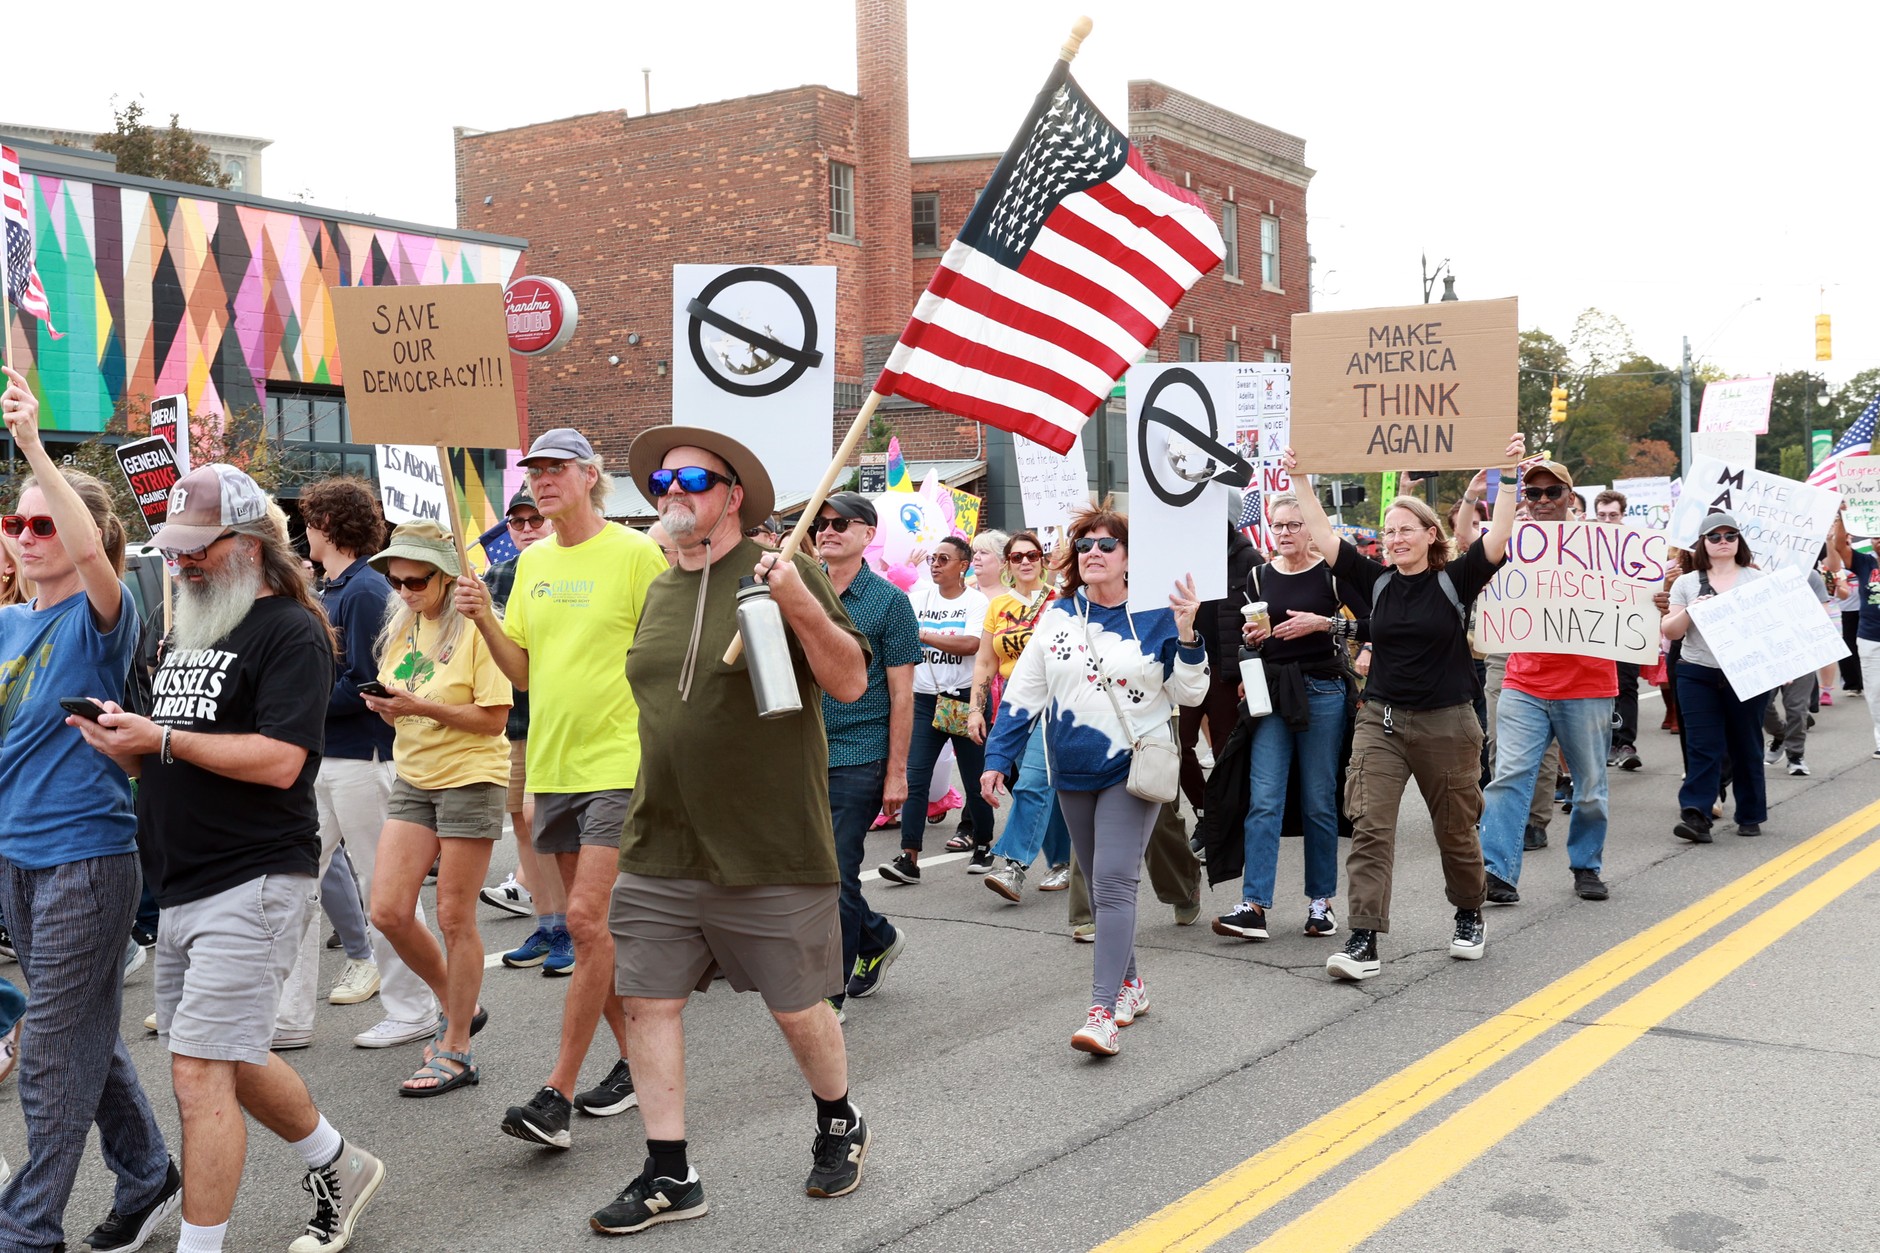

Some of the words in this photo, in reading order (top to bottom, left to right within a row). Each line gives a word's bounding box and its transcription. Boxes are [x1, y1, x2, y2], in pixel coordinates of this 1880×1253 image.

[504, 287, 551, 315] Grandma
[372, 302, 439, 335] SAVE
[507, 310, 551, 334] BOBS
[1368, 322, 1442, 348] MAKE
[393, 338, 436, 365] OUR
[1346, 347, 1457, 375] AMERICA
[363, 357, 503, 393] DEMOCRACY!!!
[1353, 382, 1460, 418] THINK
[1719, 387, 1743, 398] ALL
[152, 406, 177, 427] GENERAL
[1264, 422, 1273, 430] NO
[1705, 420, 1733, 432] NONE
[1366, 423, 1454, 455] AGAIN
[123, 448, 173, 475] GENERAL
[382, 444, 402, 471] IS
[403, 450, 444, 487] ABOVE
[1838, 460, 1880, 480] Congres
[130, 467, 177, 495] STRIKE
[1839, 483, 1856, 495] Do
[1856, 481, 1875, 494] Your
[139, 489, 168, 506] AGAINST
[384, 486, 410, 513] THE
[412, 493, 441, 521] LAW
[1557, 523, 1667, 583] KINGS
[1481, 569, 1528, 601] NO
[1483, 607, 1534, 644] NO
[921, 650, 963, 665] HICAGO
[152, 696, 217, 721] ARDER
